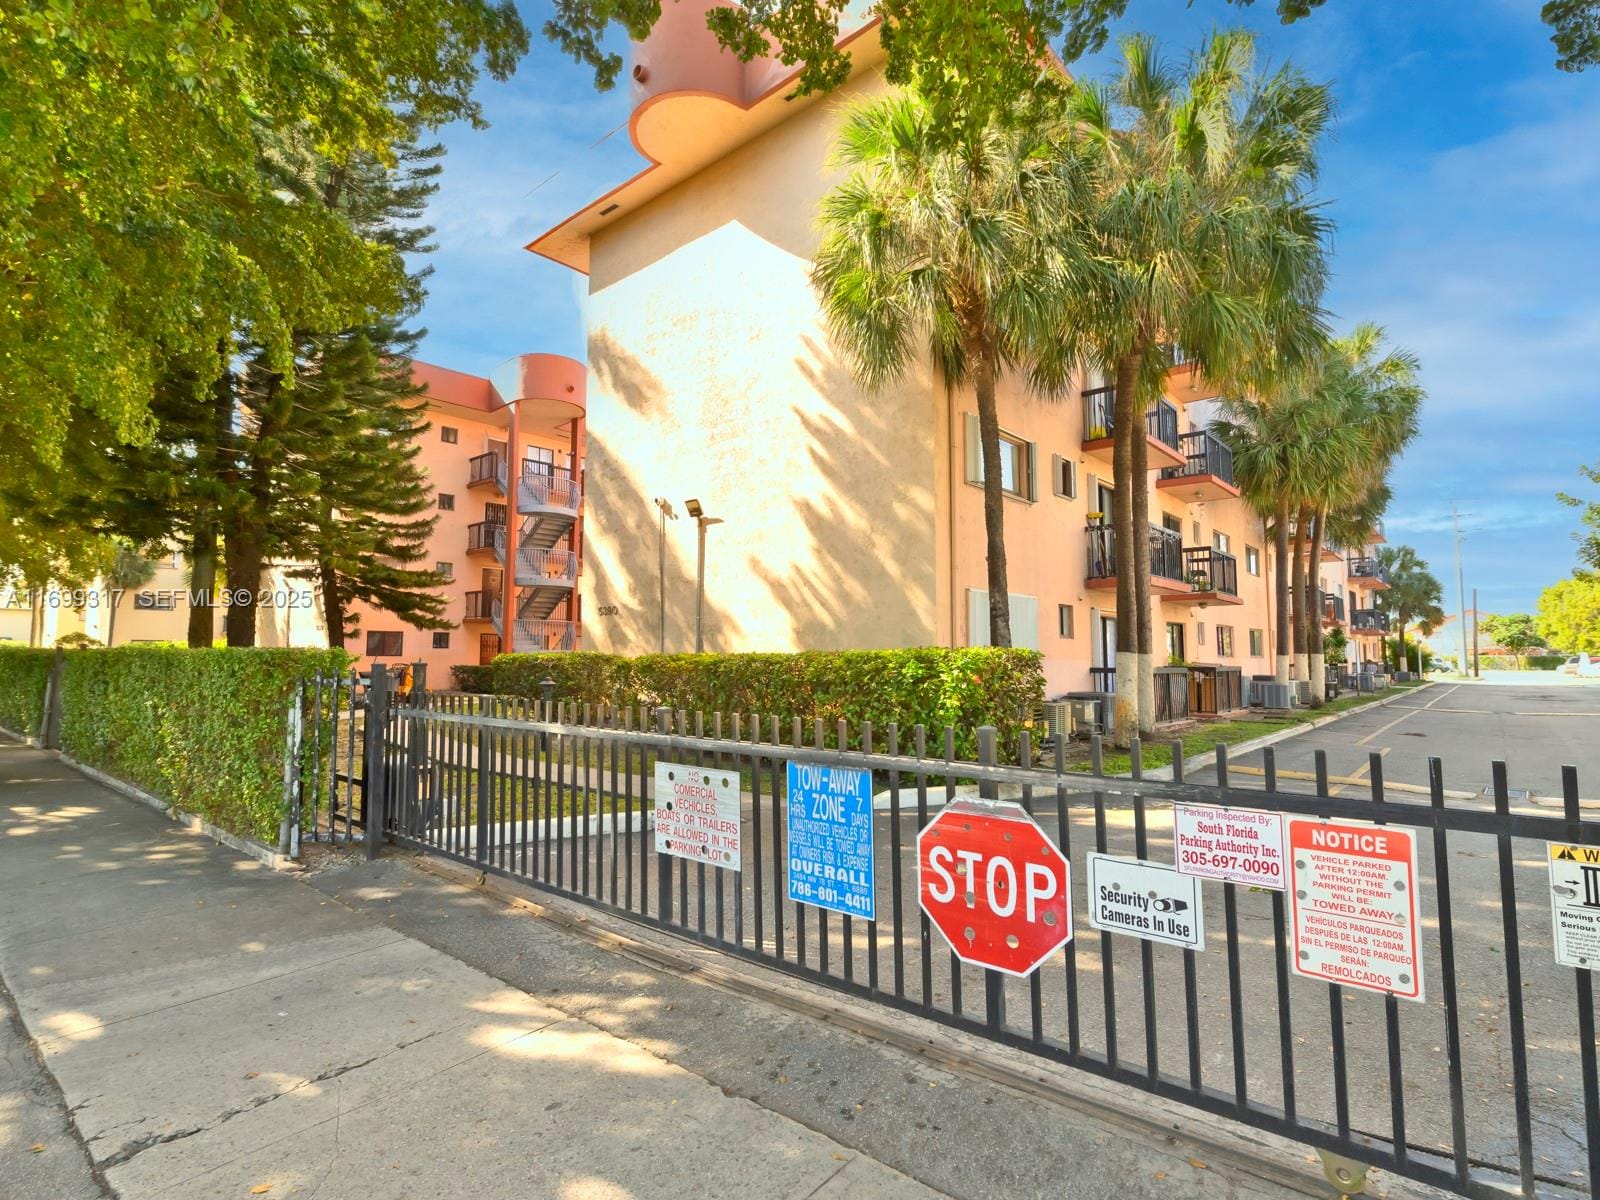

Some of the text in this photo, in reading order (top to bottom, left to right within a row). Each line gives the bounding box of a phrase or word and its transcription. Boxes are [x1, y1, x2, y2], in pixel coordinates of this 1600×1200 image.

[689, 771, 700, 783] NO
[796, 765, 860, 796] TOW-AWAY
[674, 784, 718, 800] COMERCIAL
[790, 802, 868, 828] HRS DAYS
[792, 788, 863, 823] 24 ZONE 7
[1183, 807, 1272, 826] Parking Inspected By:
[656, 808, 738, 835] BOATS OR TRAILERS
[792, 818, 868, 842] UNAUTHORIZED VEHICLES OR
[1197, 821, 1259, 840] South Florida
[656, 822, 738, 850] ARE ALLOWED IN THE
[790, 831, 870, 857] VESSELS WILL BE TOWED AWAY
[1180, 834, 1280, 858] Parking Authority Inc.
[1312, 829, 1388, 854] NOTICE
[670, 840, 722, 860] PARKING LOT
[822, 850, 835, 865] RISK
[843, 854, 868, 872] EXPENSE
[791, 858, 869, 887] OVERALL
[1182, 850, 1280, 876] 305-697-0090
[1310, 854, 1392, 872] VEHICLE PARKED
[1314, 864, 1388, 880] AFTER 12:00AM.
[928, 846, 1057, 924] STOP
[1312, 881, 1392, 900] PARKING PERMIT
[1320, 873, 1384, 889] WITHOUT THE
[791, 880, 870, 912] 786-801-4411
[1100, 885, 1150, 912] Security
[1332, 892, 1354, 902] WILL
[1101, 905, 1190, 938] Cameras In Use
[1312, 899, 1394, 920] TOWED AWAY
[1560, 912, 1594, 922] Moving
[1304, 926, 1339, 940] DESPUÉS
[1340, 932, 1351, 942] DE
[1353, 936, 1368, 945] LAS
[1306, 915, 1404, 940] VEHÍCULOS PARQUEADOS
[1560, 922, 1596, 932] Serious
[1300, 936, 1412, 964] SIN EL PERMISO DE PARQUEO
[1321, 962, 1392, 986] REMOLCADOS
